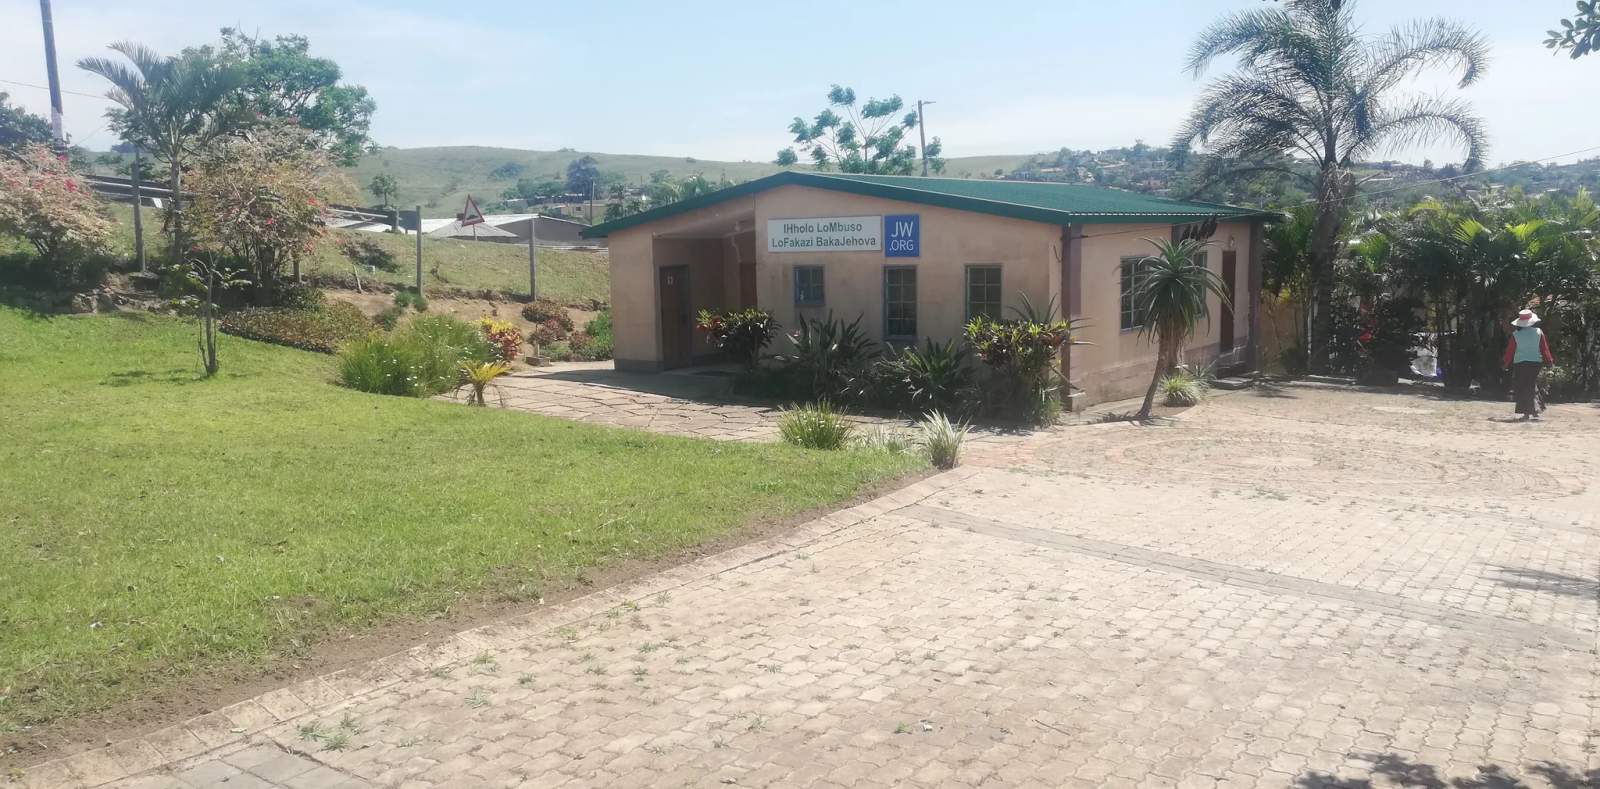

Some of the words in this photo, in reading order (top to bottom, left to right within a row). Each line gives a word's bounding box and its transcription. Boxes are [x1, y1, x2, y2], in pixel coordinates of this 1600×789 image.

[783, 223, 814, 234] IHholo
[817, 222, 862, 233] LoMbuso
[891, 221, 914, 238] JW
[772, 237, 814, 248] LoFakazi
[816, 236, 876, 247] BakaJehova
[889, 239, 914, 251] .ORG
